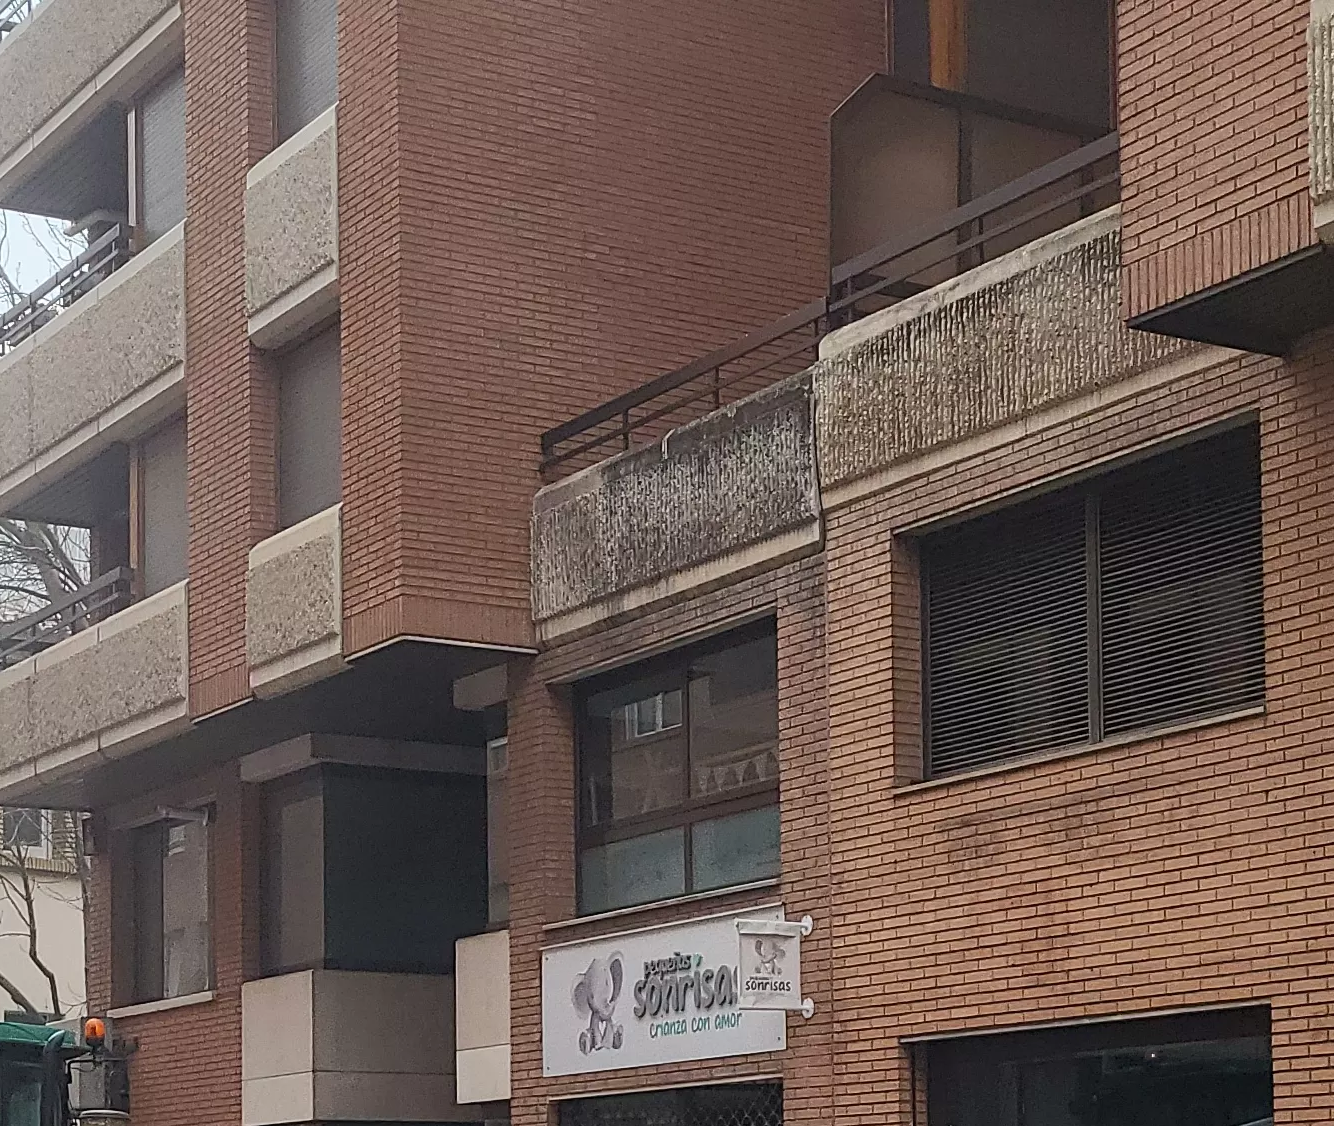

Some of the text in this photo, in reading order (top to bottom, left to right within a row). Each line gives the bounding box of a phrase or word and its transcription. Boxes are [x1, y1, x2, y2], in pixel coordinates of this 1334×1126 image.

[745, 980, 792, 992] sonrisas
[691, 1016, 710, 1033] con
[714, 1012, 743, 1030] amor
